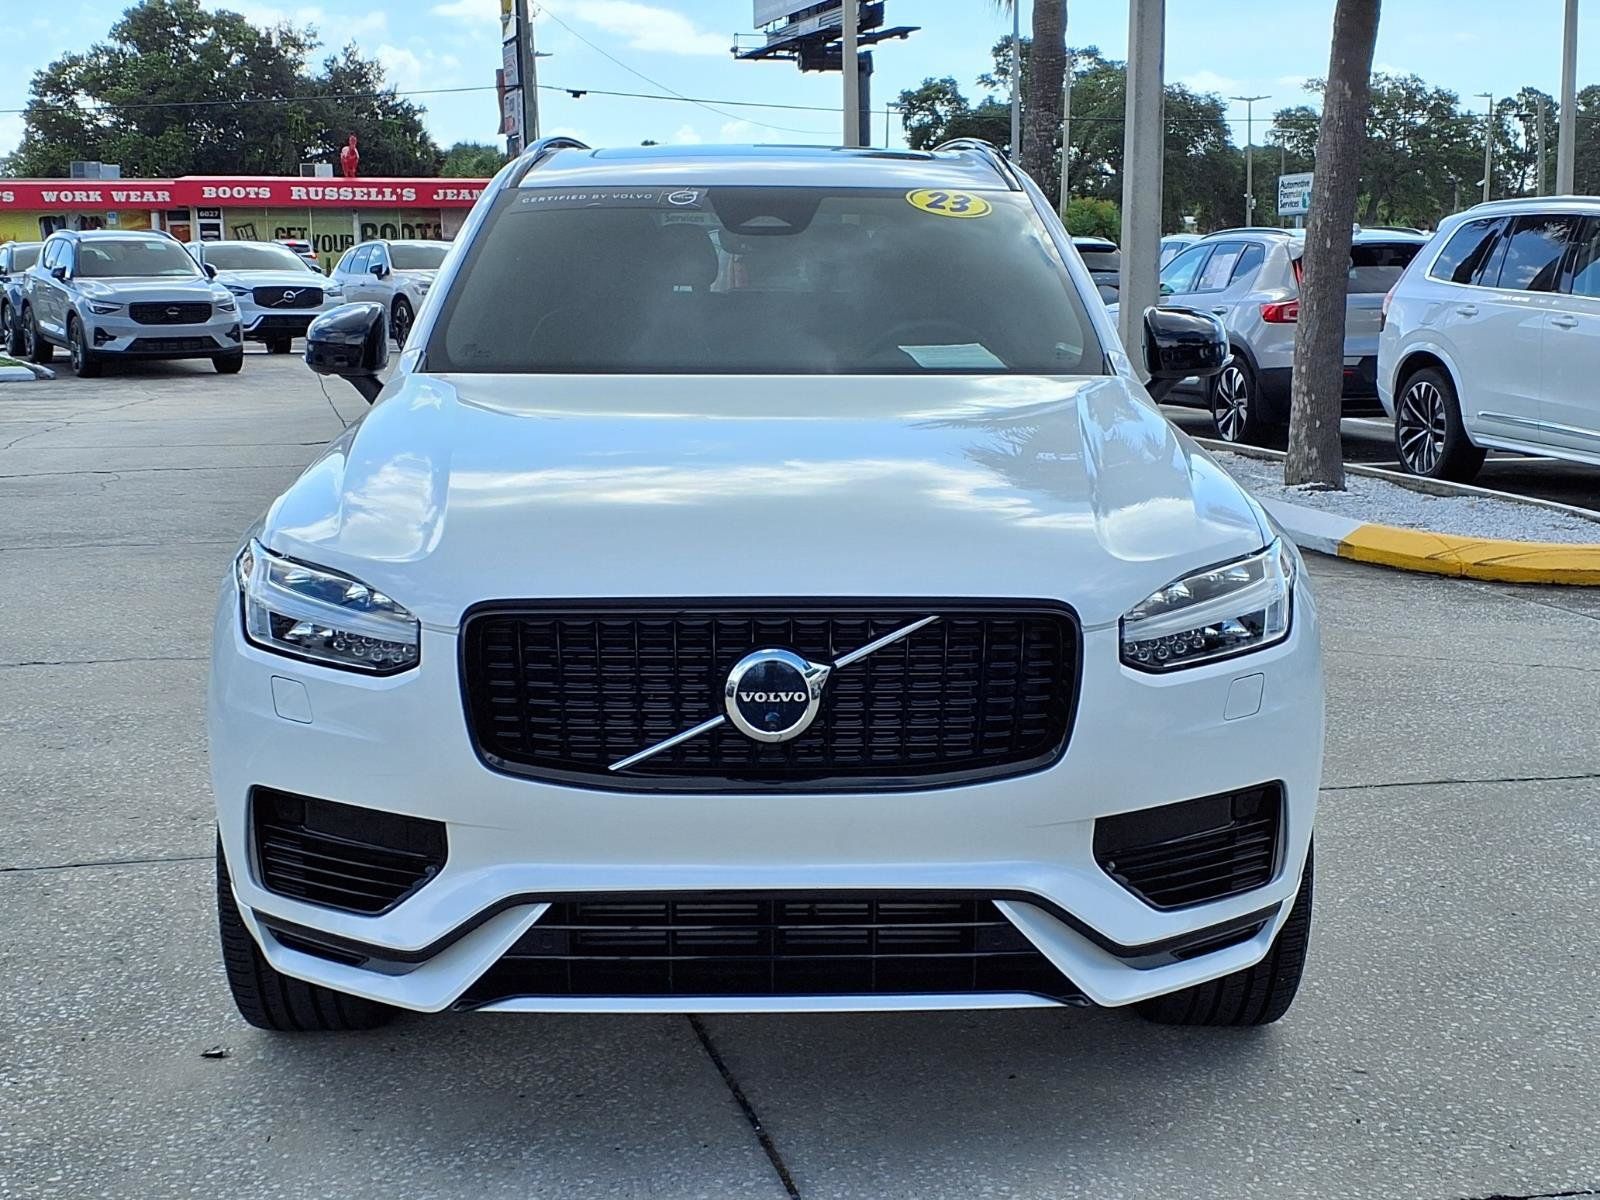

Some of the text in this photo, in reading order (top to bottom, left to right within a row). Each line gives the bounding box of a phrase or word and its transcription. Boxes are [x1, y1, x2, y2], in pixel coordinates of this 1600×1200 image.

[41, 191, 102, 202] WORK
[110, 190, 171, 202] WEAR
[202, 186, 271, 199] BOOTS
[290, 187, 417, 201] RUSSELL'S
[522, 194, 587, 204] CERTIFIED
[925, 191, 972, 213] 23
[1280, 200, 1300, 209] Services
[738, 691, 807, 703] VOLVO
